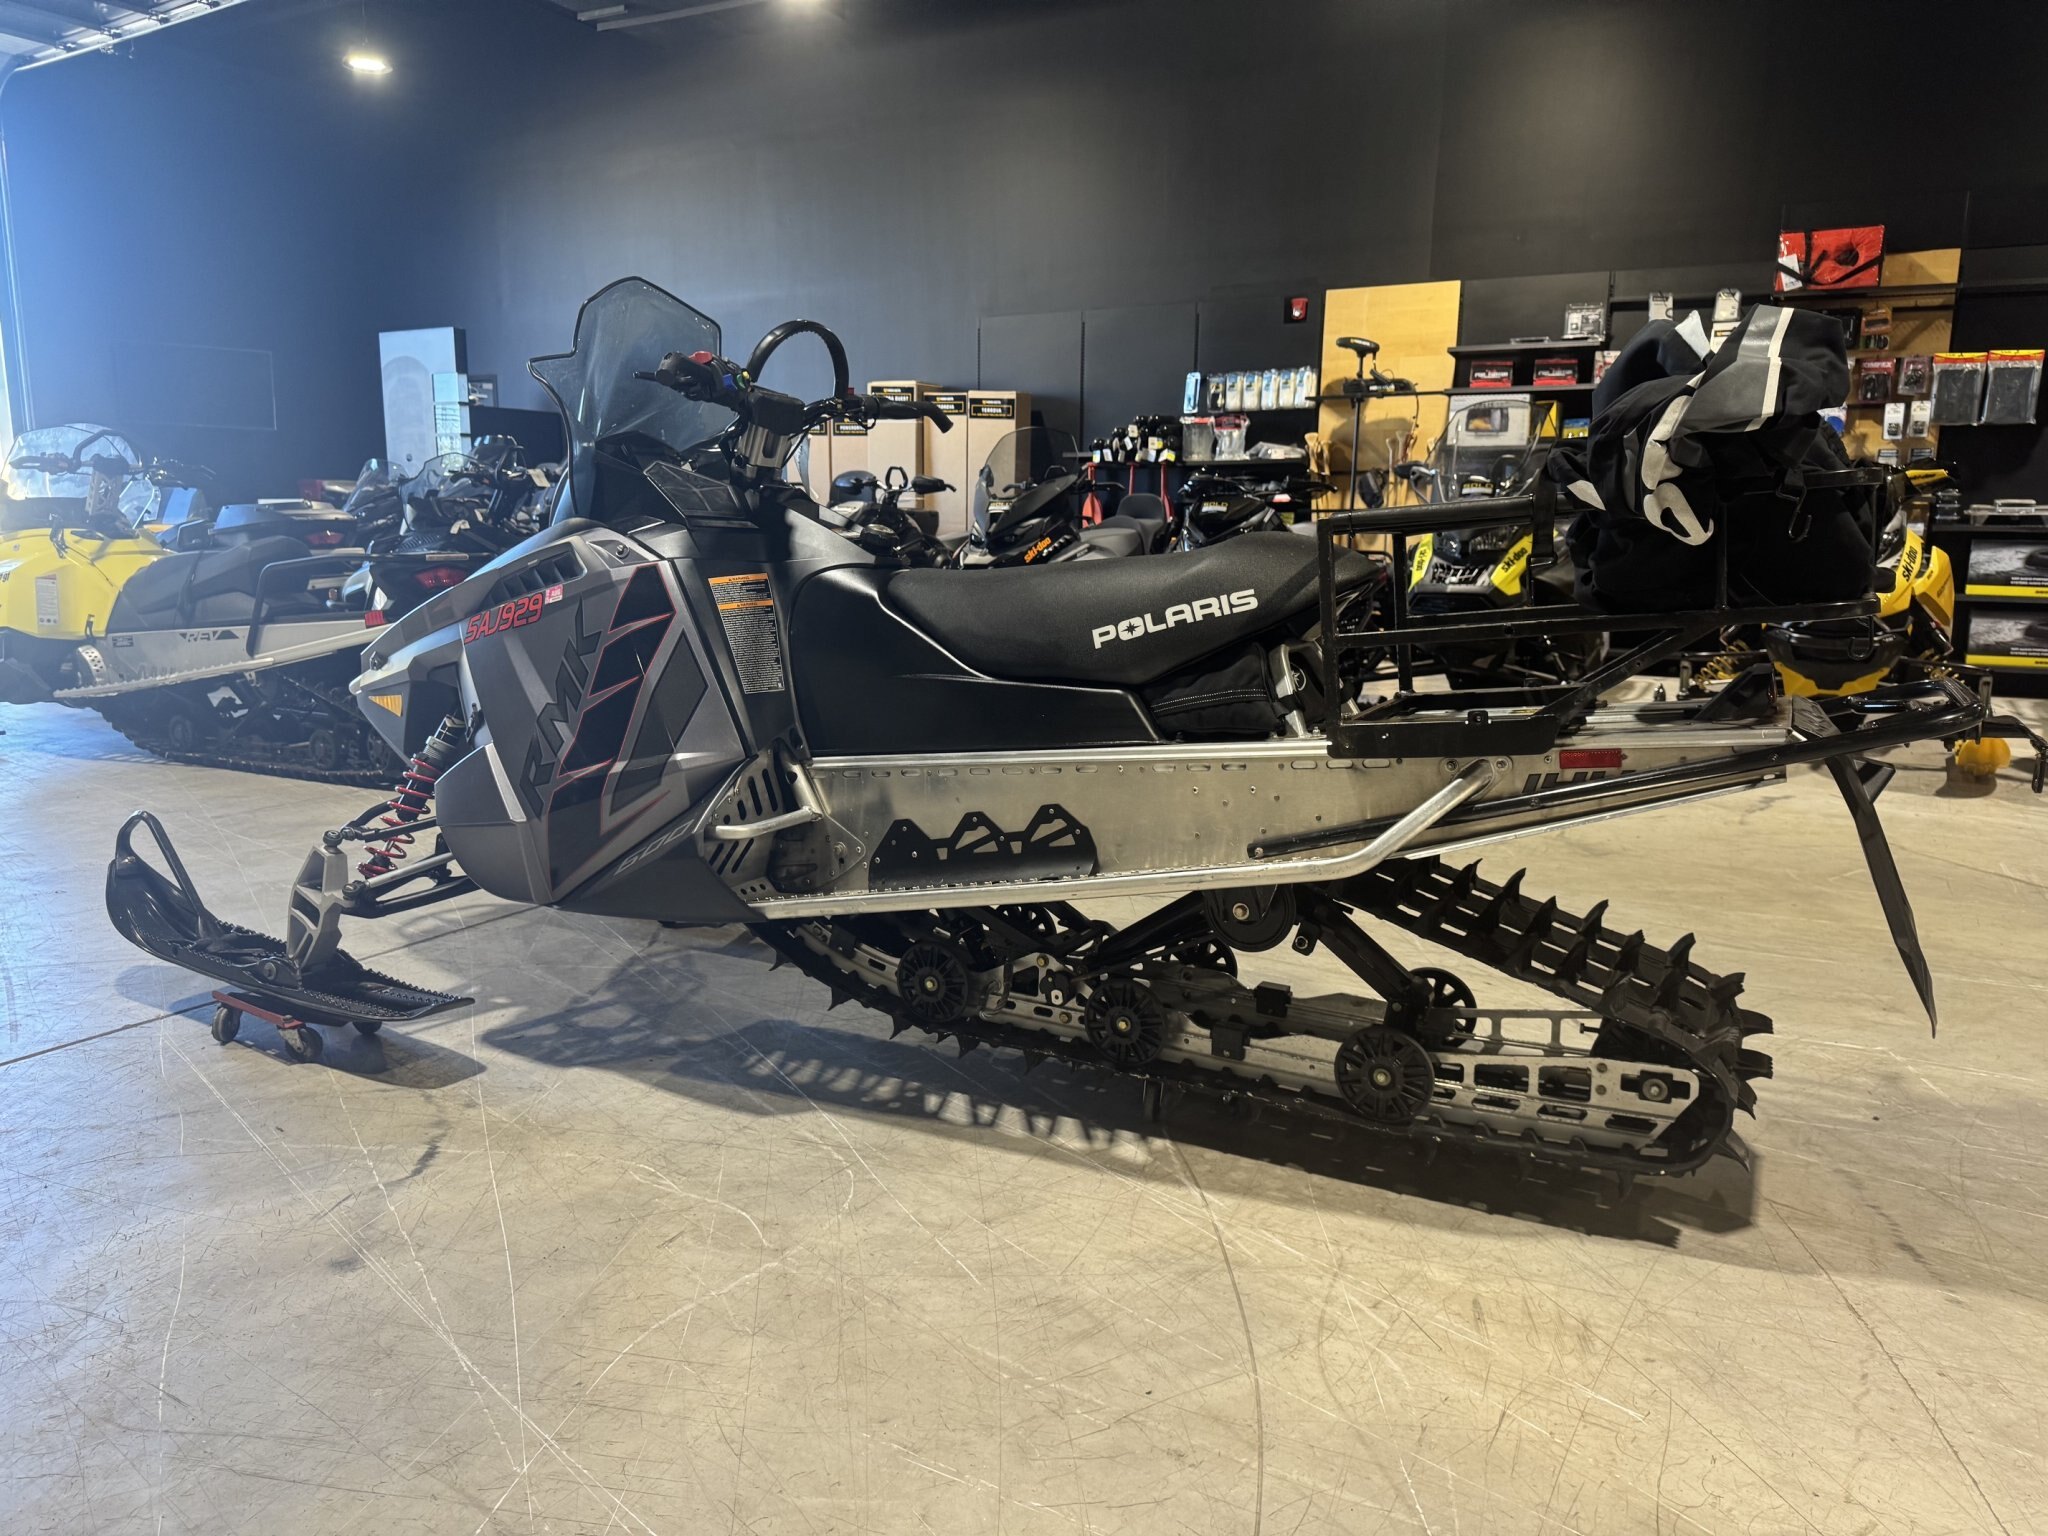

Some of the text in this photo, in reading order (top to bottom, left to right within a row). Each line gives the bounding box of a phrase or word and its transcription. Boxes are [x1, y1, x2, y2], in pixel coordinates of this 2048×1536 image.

[1024, 537, 1052, 563] ski-doo
[1500, 547, 1529, 573] ski-doo
[1901, 545, 1918, 583] ski-doo
[1091, 588, 1259, 650] POLARIS
[184, 630, 220, 642] REV
[519, 592, 602, 823] RMK
